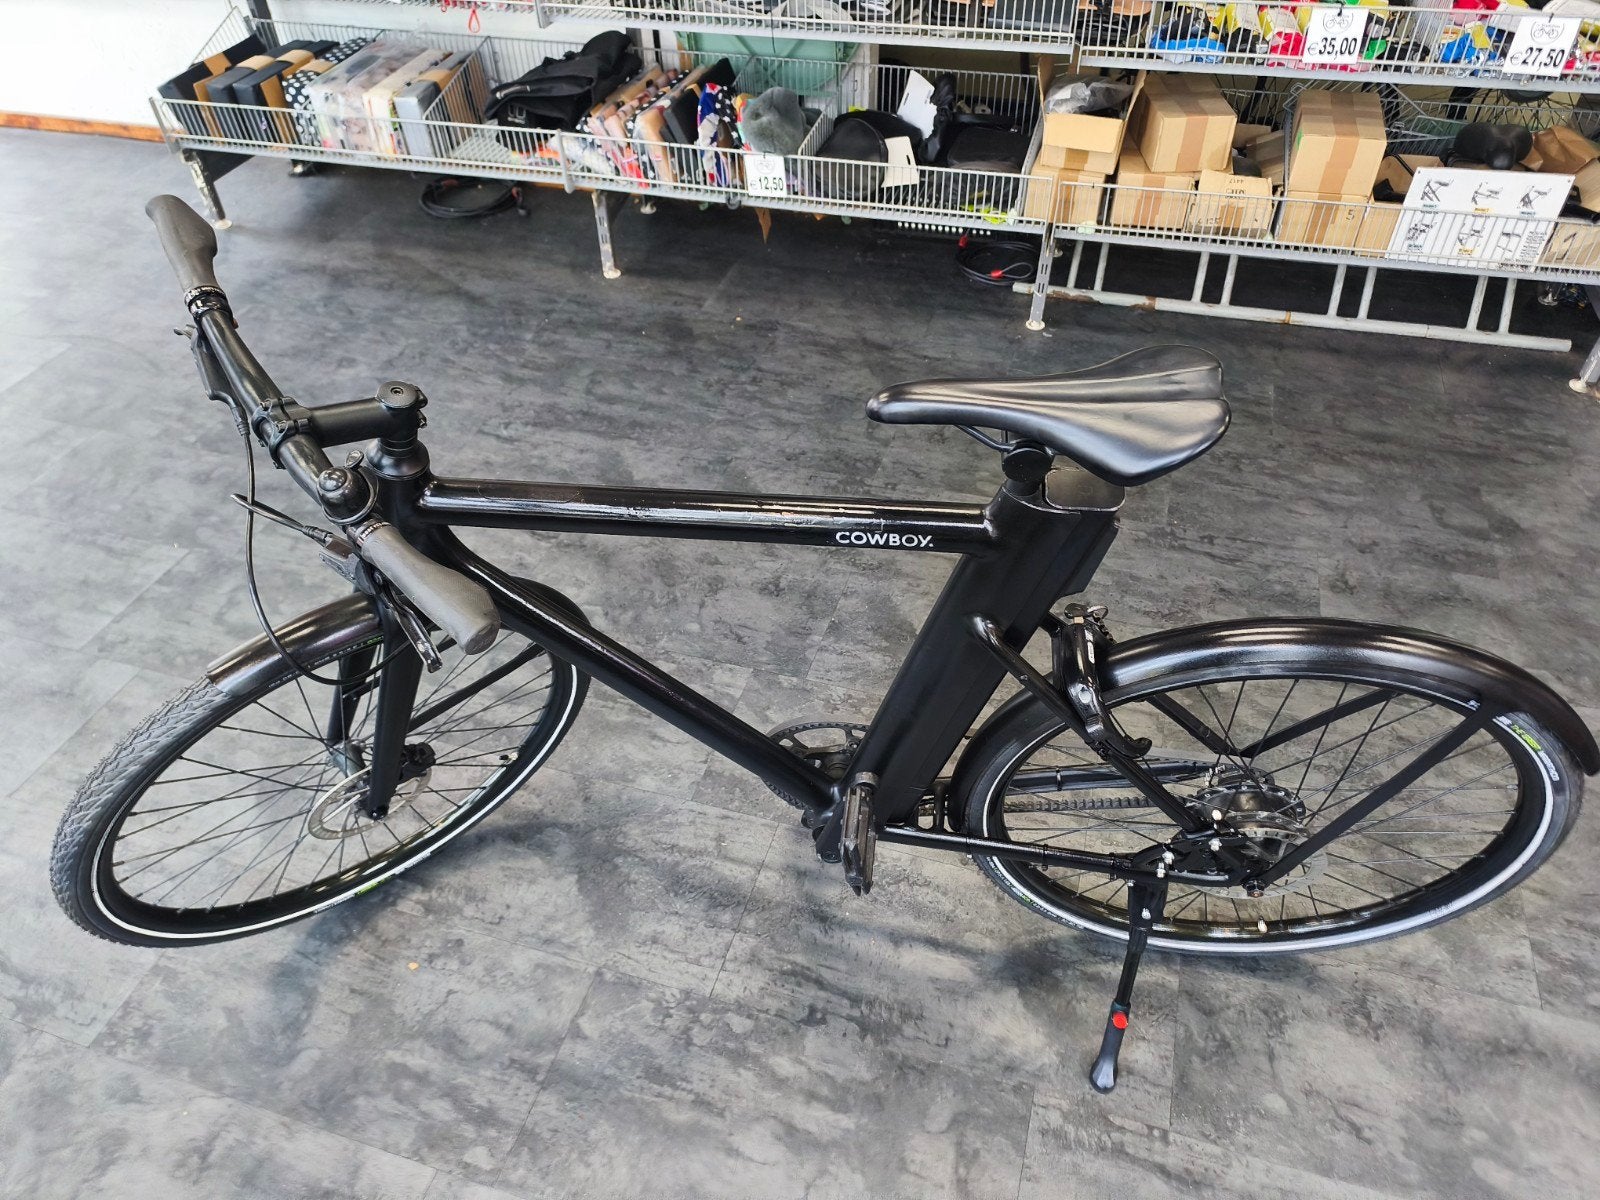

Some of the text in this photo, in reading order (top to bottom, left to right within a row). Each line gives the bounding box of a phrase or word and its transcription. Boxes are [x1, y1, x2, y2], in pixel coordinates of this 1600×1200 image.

[1308, 37, 1358, 61] €35,00
[1510, 46, 1565, 72] €27,50
[750, 176, 783, 193] €12,50
